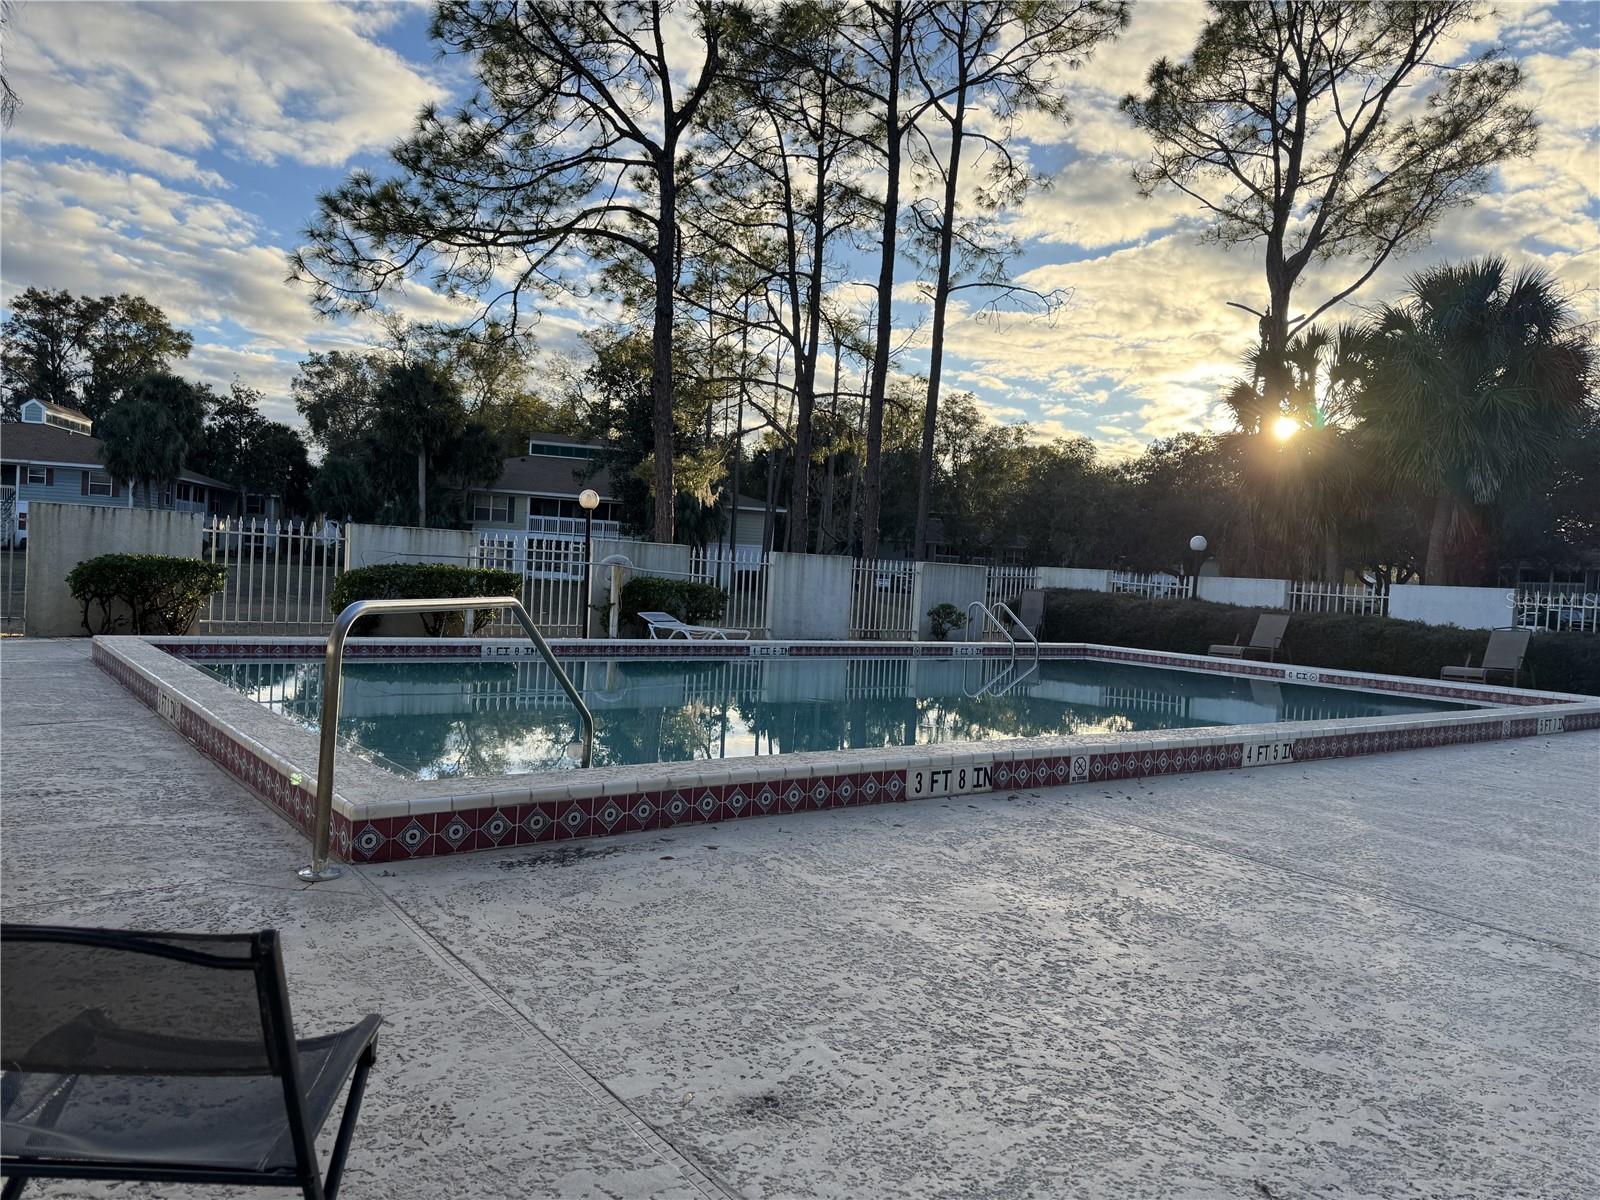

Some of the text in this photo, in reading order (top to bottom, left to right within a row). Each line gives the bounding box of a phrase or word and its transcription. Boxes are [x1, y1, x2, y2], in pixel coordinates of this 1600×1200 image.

[1247, 743, 1295, 763] 4 FT 5 IN
[914, 766, 993, 794] 3 FT 8 IN
